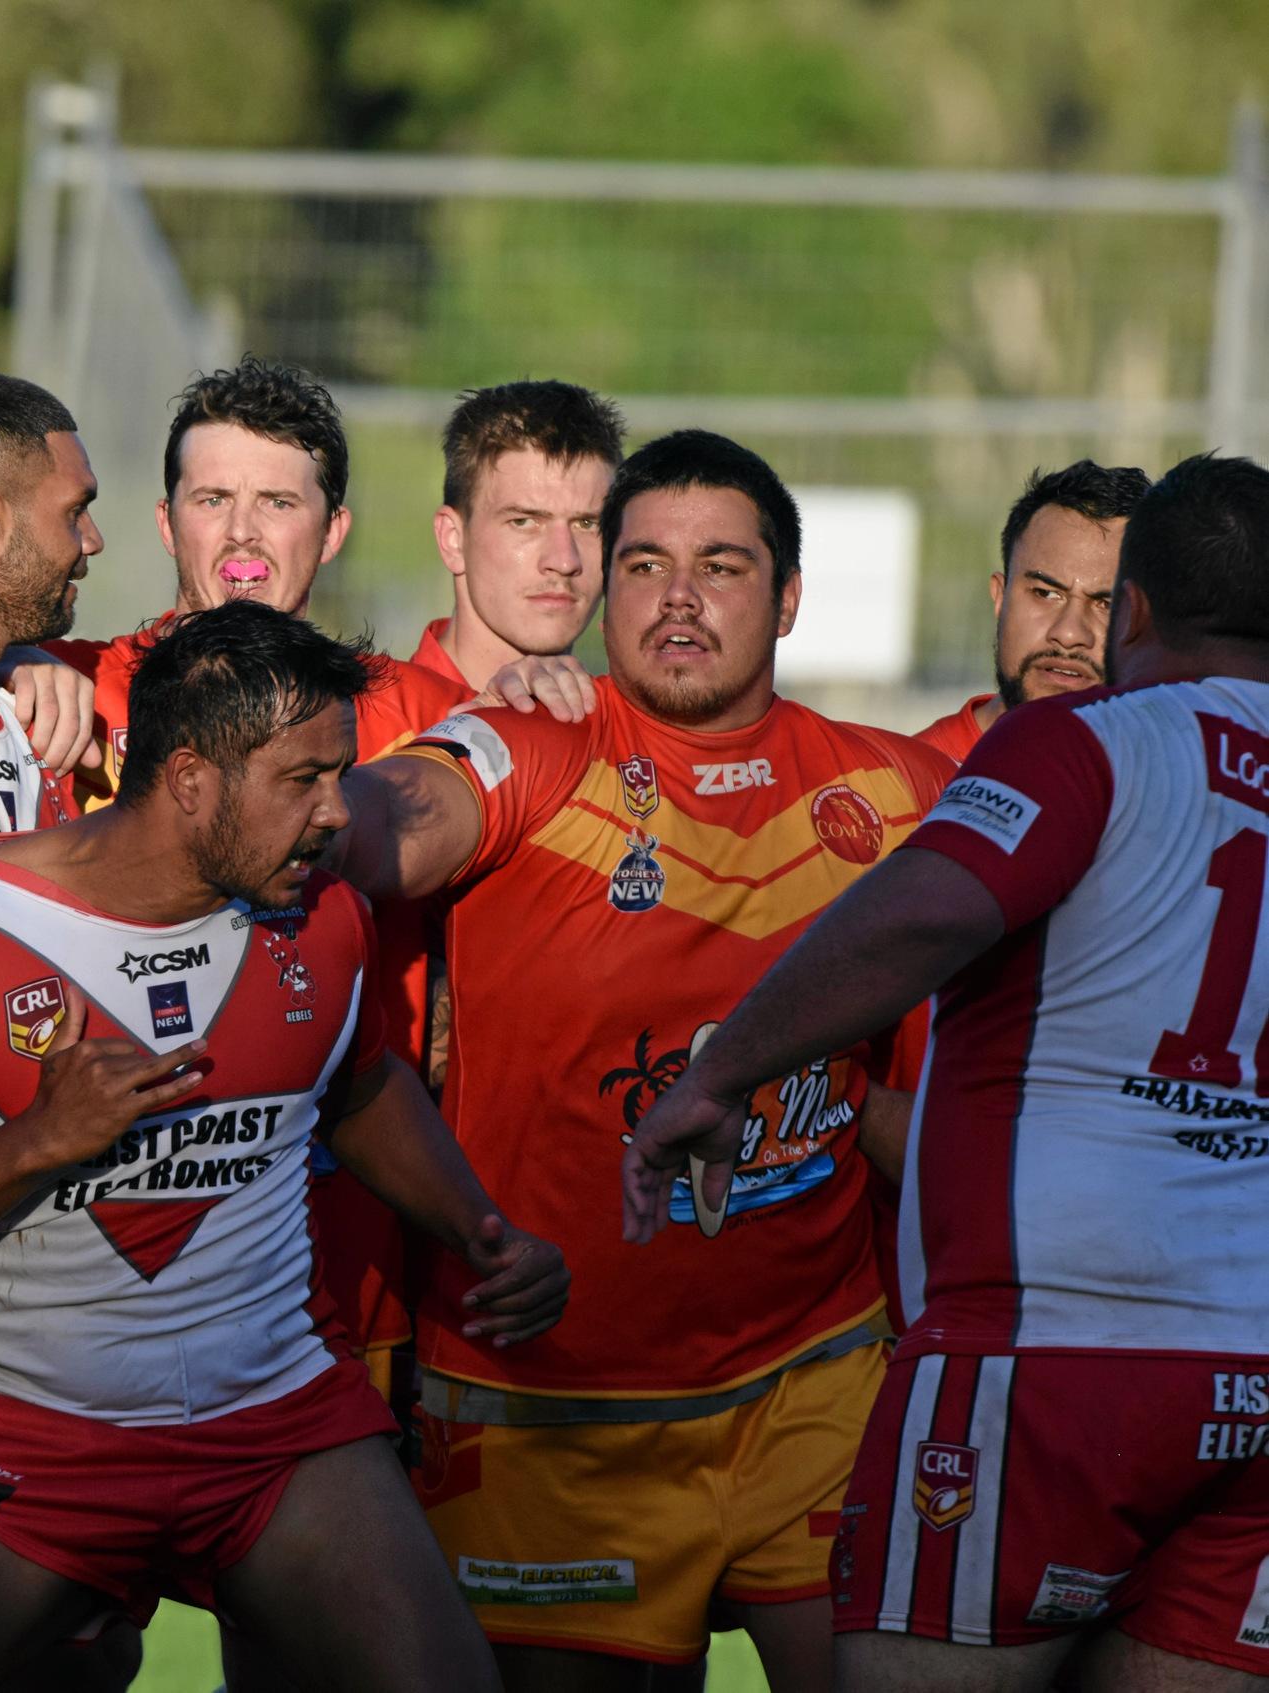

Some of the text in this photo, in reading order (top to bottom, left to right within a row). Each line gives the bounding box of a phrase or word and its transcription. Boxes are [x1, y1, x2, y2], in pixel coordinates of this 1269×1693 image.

[692, 758, 778, 796] ZBR
[815, 819, 881, 851] COMTS
[611, 879, 666, 902] NEW
[148, 942, 212, 975] CSM
[11, 985, 59, 1017] CRL
[156, 1014, 188, 1029] NEW
[284, 1009, 314, 1024] REBELS
[170, 1103, 284, 1155] COAST
[763, 1150, 778, 1164] On
[781, 1143, 804, 1159] The
[1212, 1372, 1269, 1416] EAS
[922, 1449, 970, 1478] CRL
[520, 1564, 622, 1585] ELECTRICAL
